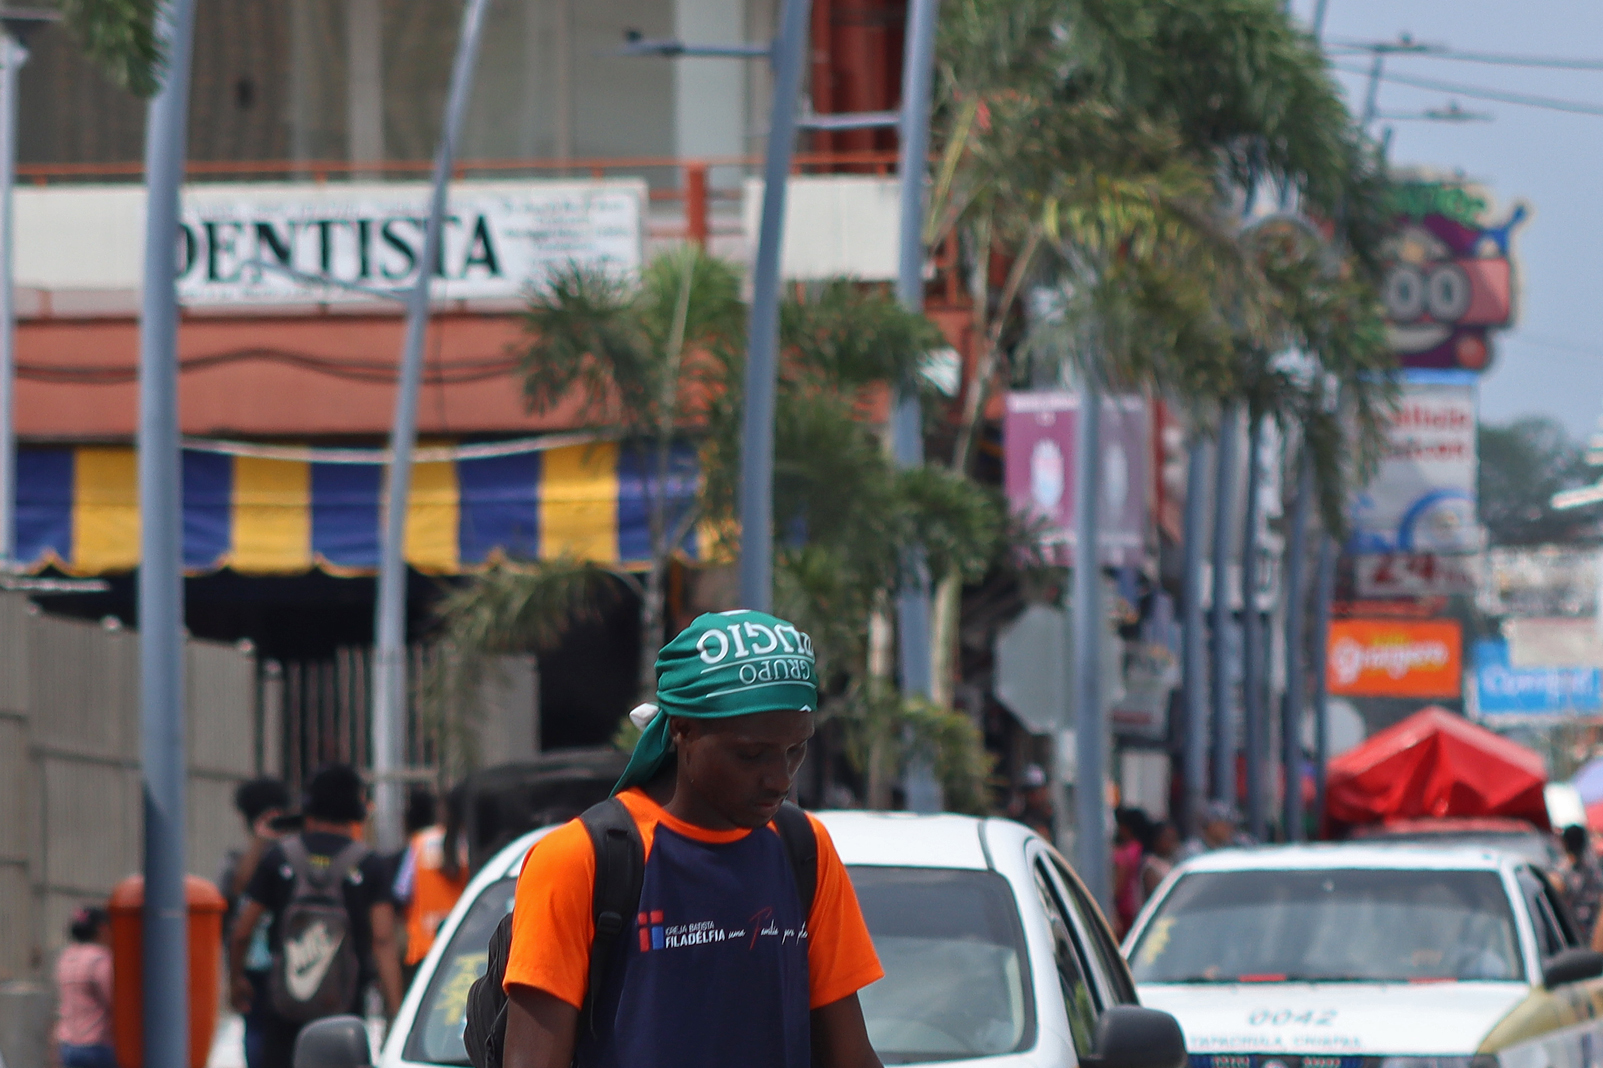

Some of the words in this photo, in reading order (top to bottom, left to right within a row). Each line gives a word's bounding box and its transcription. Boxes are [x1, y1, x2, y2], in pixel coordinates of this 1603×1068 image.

[739, 659, 810, 685] GRUPO
[689, 920, 714, 932] BATISTA
[1248, 1008, 1338, 1027] 0042
